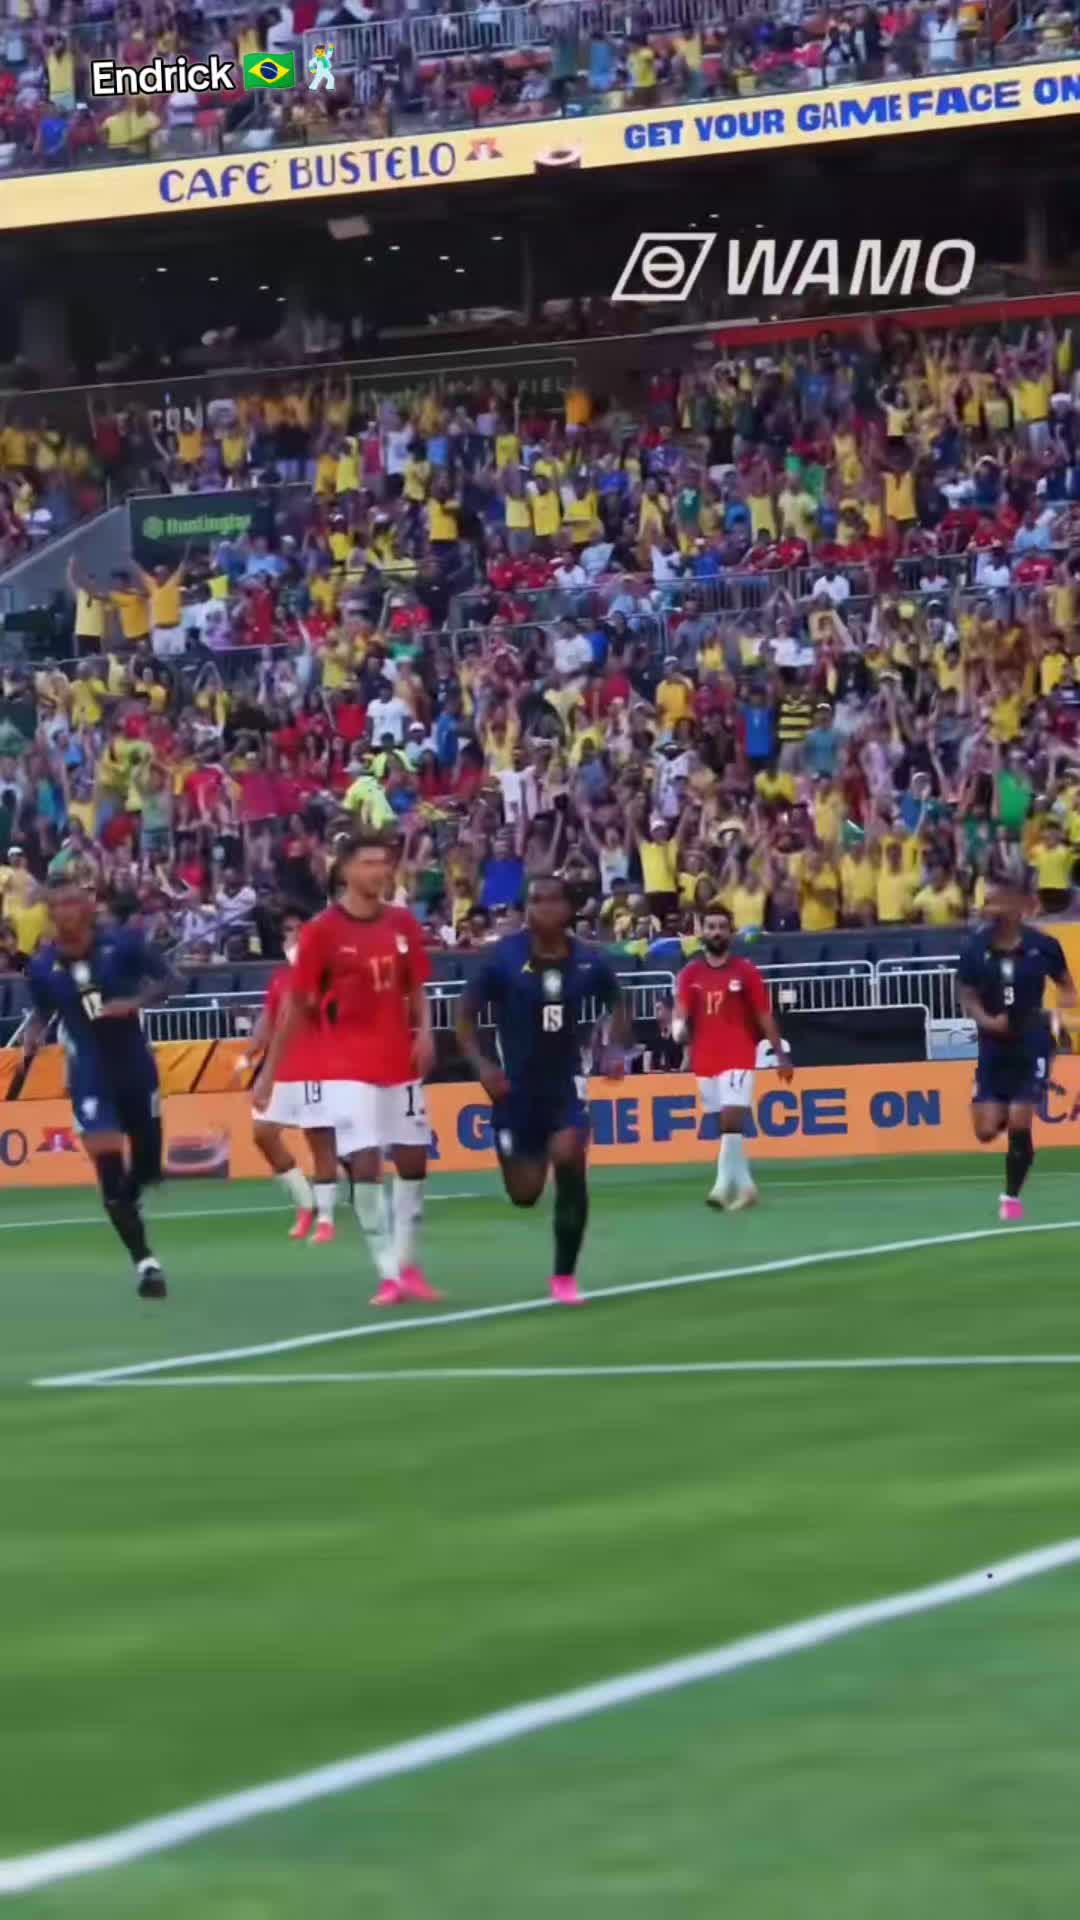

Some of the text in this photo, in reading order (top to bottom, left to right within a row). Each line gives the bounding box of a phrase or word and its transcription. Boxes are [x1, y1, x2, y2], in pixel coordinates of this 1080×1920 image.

[624, 75, 1080, 150] GET YOUR GAME FACE ON
[288, 142, 456, 190] BUSTELO
[706, 990, 723, 1015] 17
[457, 1098, 641, 1150] GE
[869, 1089, 940, 1129] ON
